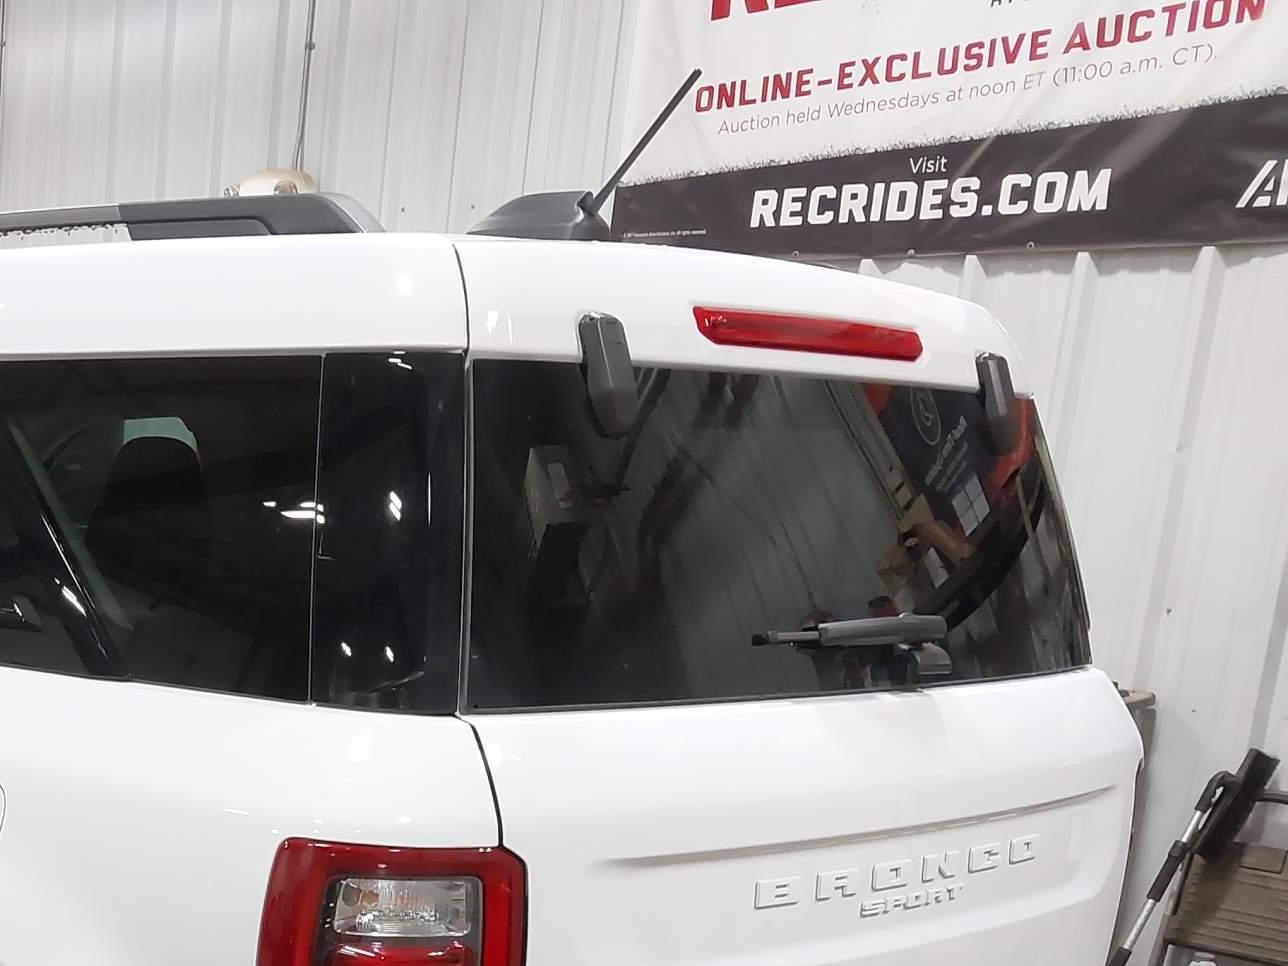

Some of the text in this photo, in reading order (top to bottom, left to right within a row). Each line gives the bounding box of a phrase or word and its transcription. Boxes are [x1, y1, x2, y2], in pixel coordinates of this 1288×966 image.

[695, 0, 1266, 113] ONLINE-EXCLUSIVE AUCTION
[717, 43, 1218, 135] Auction held Wednesdays at noon ET (11:00 a.m. CT).
[750, 168, 1112, 229] RECRIDES.COM
[910, 156, 948, 175] Visit
[754, 834, 1040, 910] BRONCO
[860, 885, 964, 919] SPORT
